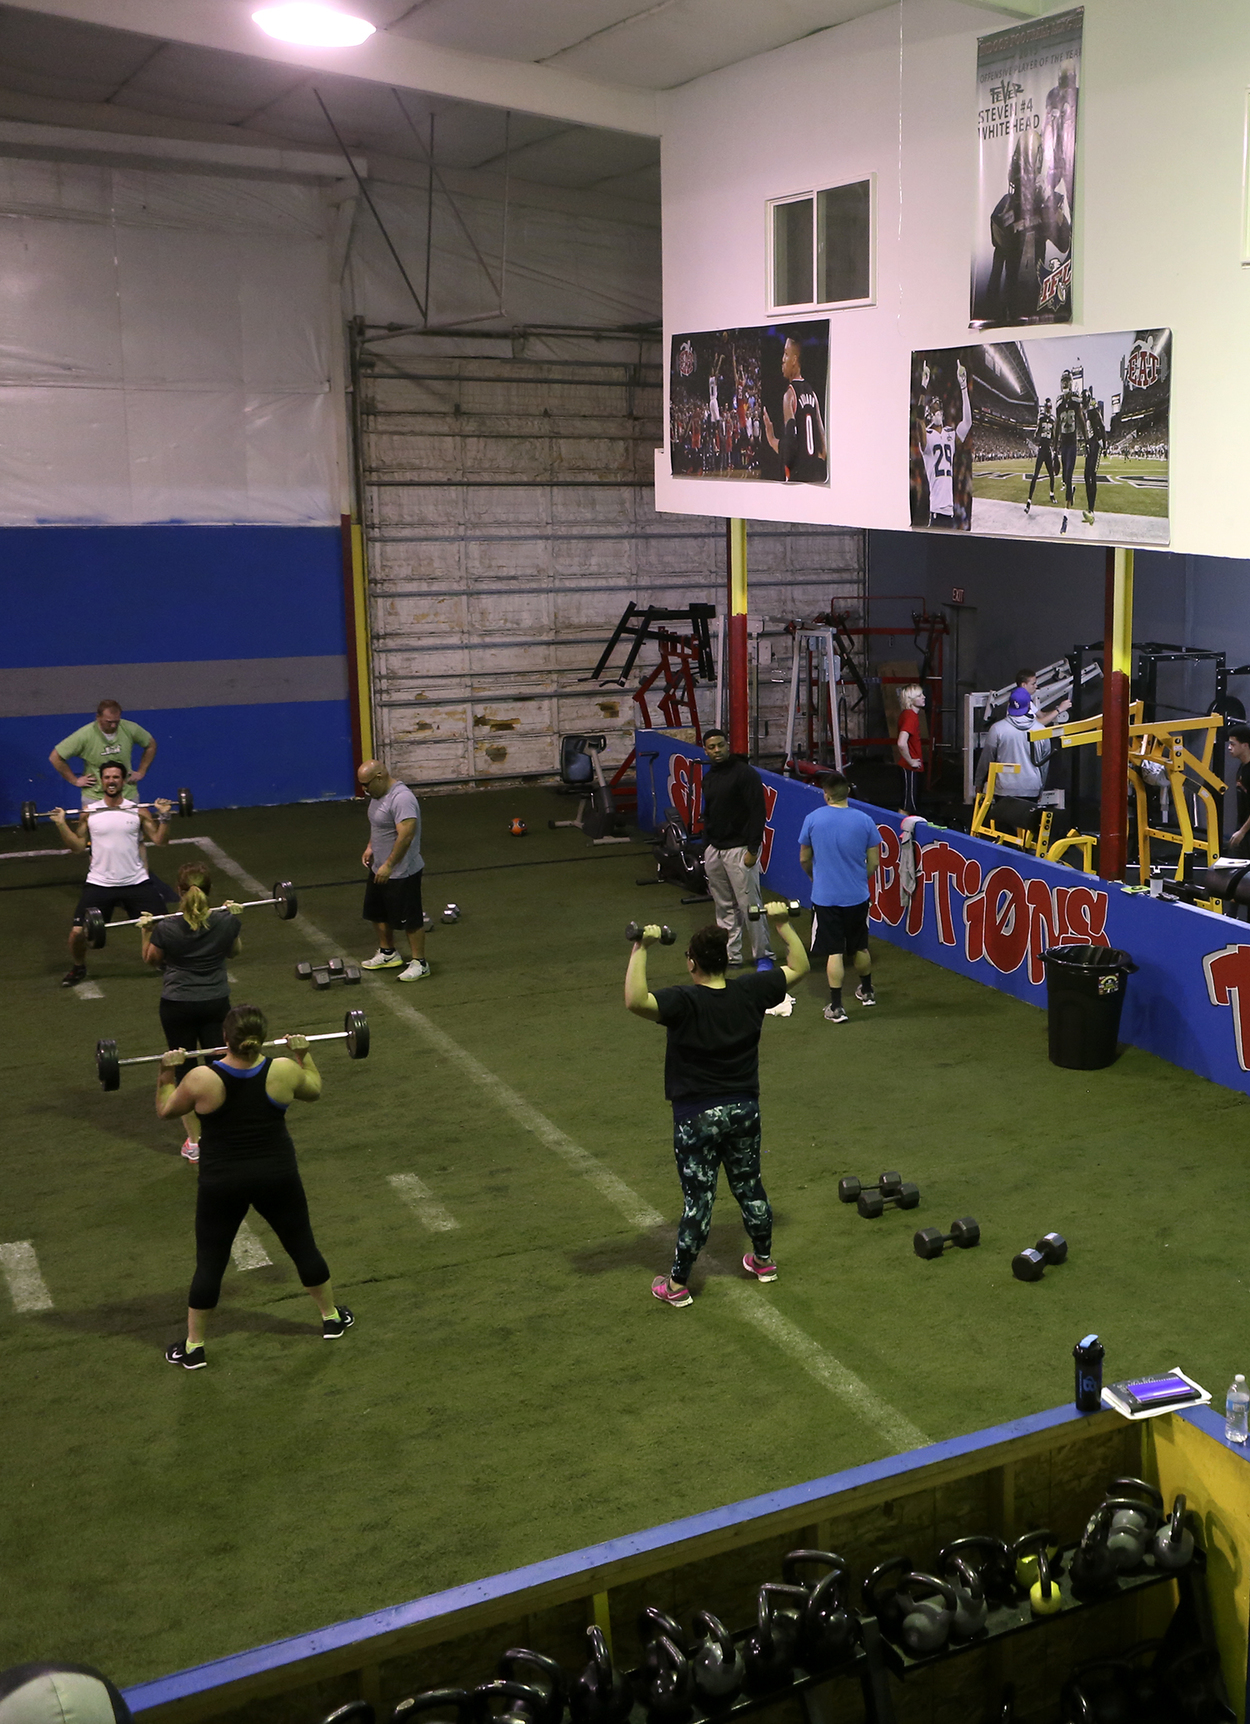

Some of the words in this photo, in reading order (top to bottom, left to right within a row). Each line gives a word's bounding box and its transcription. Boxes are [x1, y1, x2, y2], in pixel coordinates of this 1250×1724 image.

[980, 67, 1012, 83] OFFENSIVE
[1039, 56, 1049, 67] OF
[1051, 53, 1063, 64] THE
[977, 114, 1040, 140] WHITEHEAD
[978, 102, 1018, 124] STEVEN
[1020, 98, 1033, 114] #4
[1041, 262, 1071, 302] IFL
[1128, 350, 1159, 387] EAT
[806, 414, 815, 455] 0
